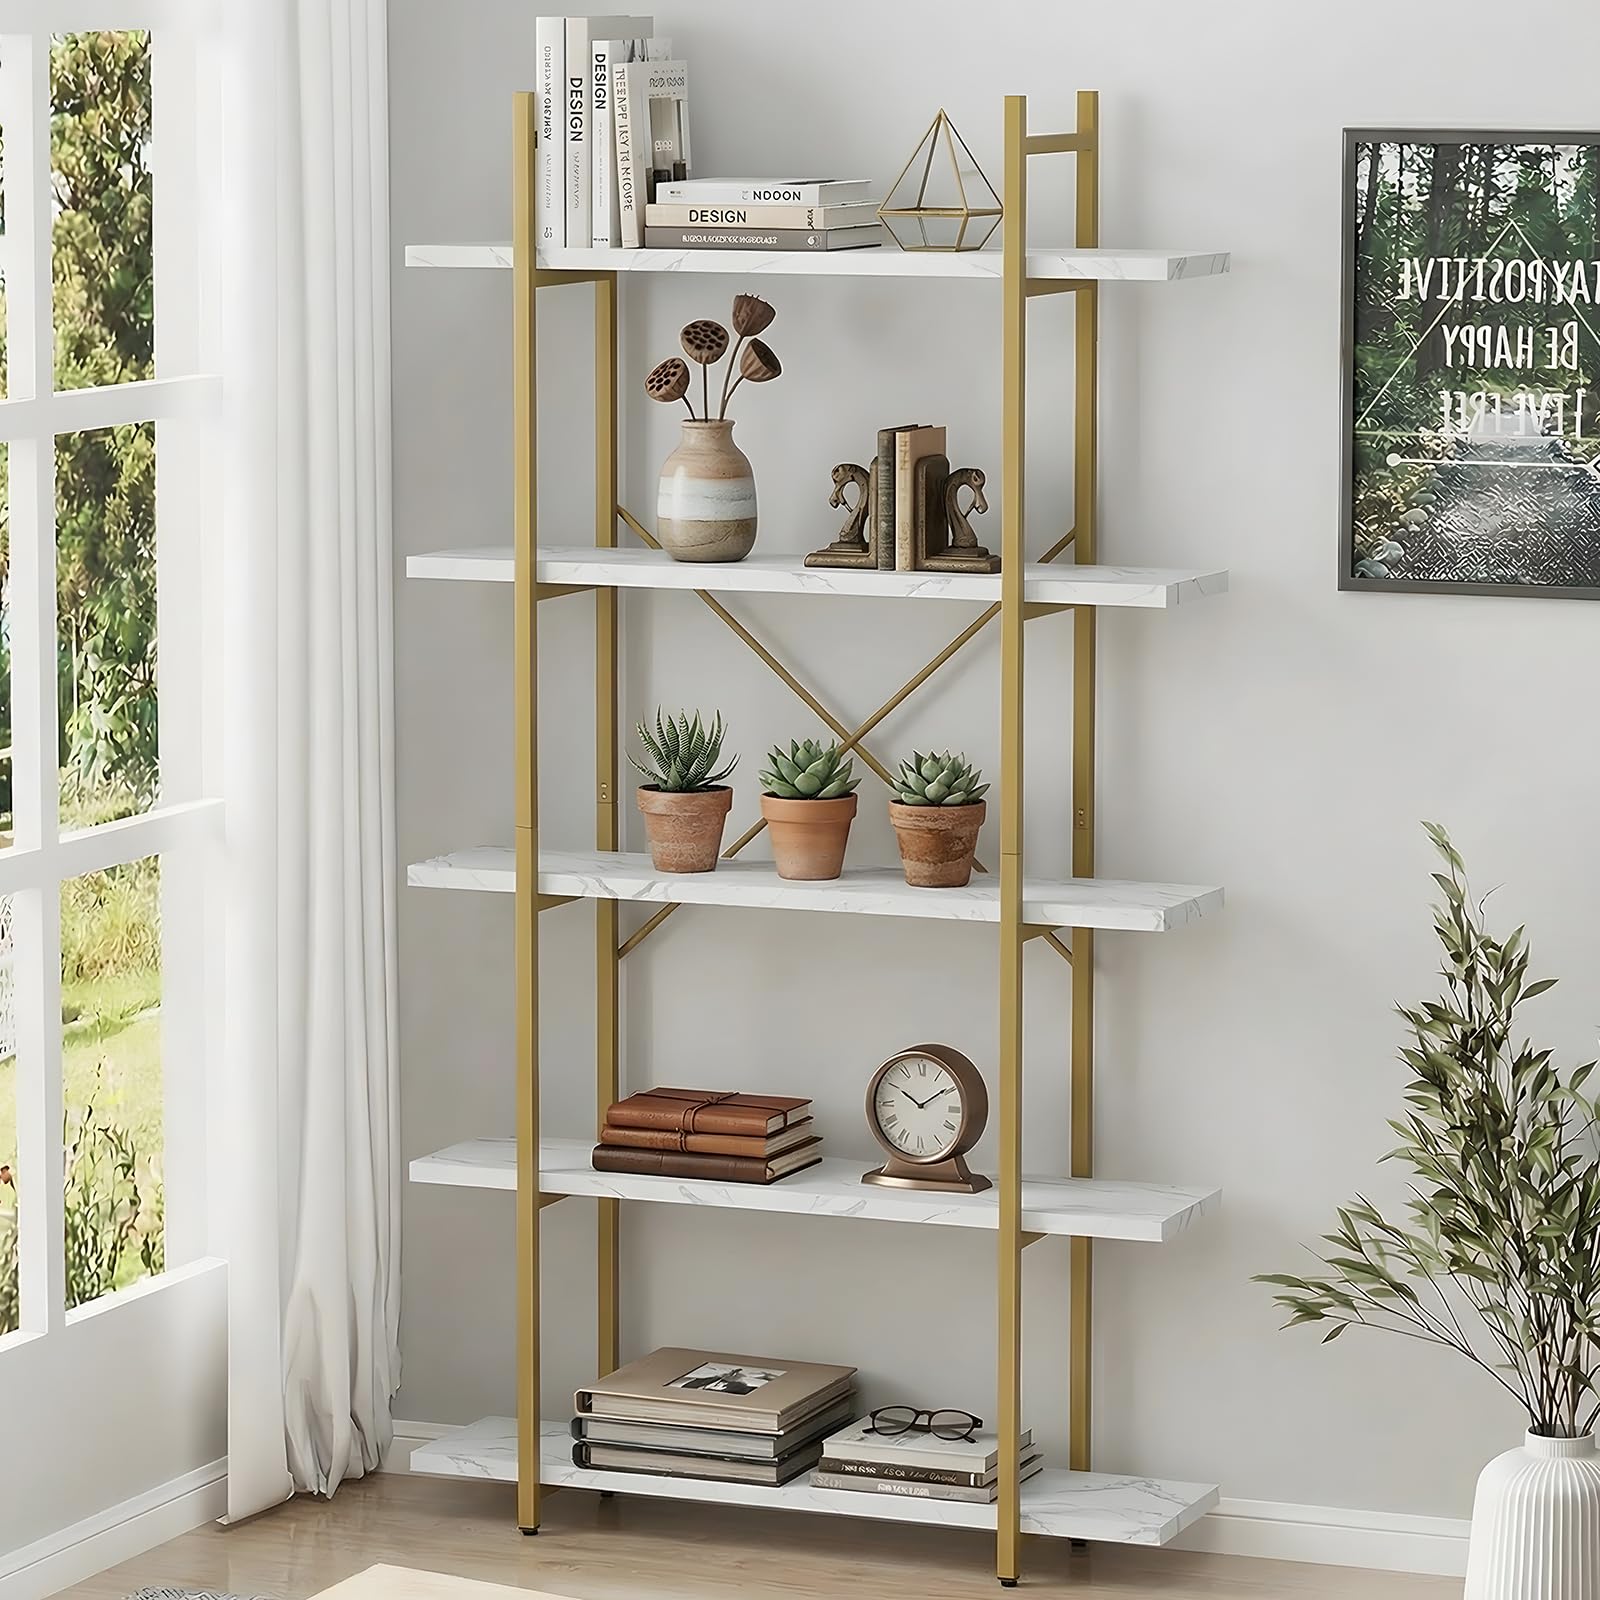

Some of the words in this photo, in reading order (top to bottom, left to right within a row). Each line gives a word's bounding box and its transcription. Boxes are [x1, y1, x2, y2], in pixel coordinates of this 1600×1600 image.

[569, 77, 584, 142] DESIGN
[594, 53, 607, 110] DESIGN
[688, 209, 747, 223] DESIGN
